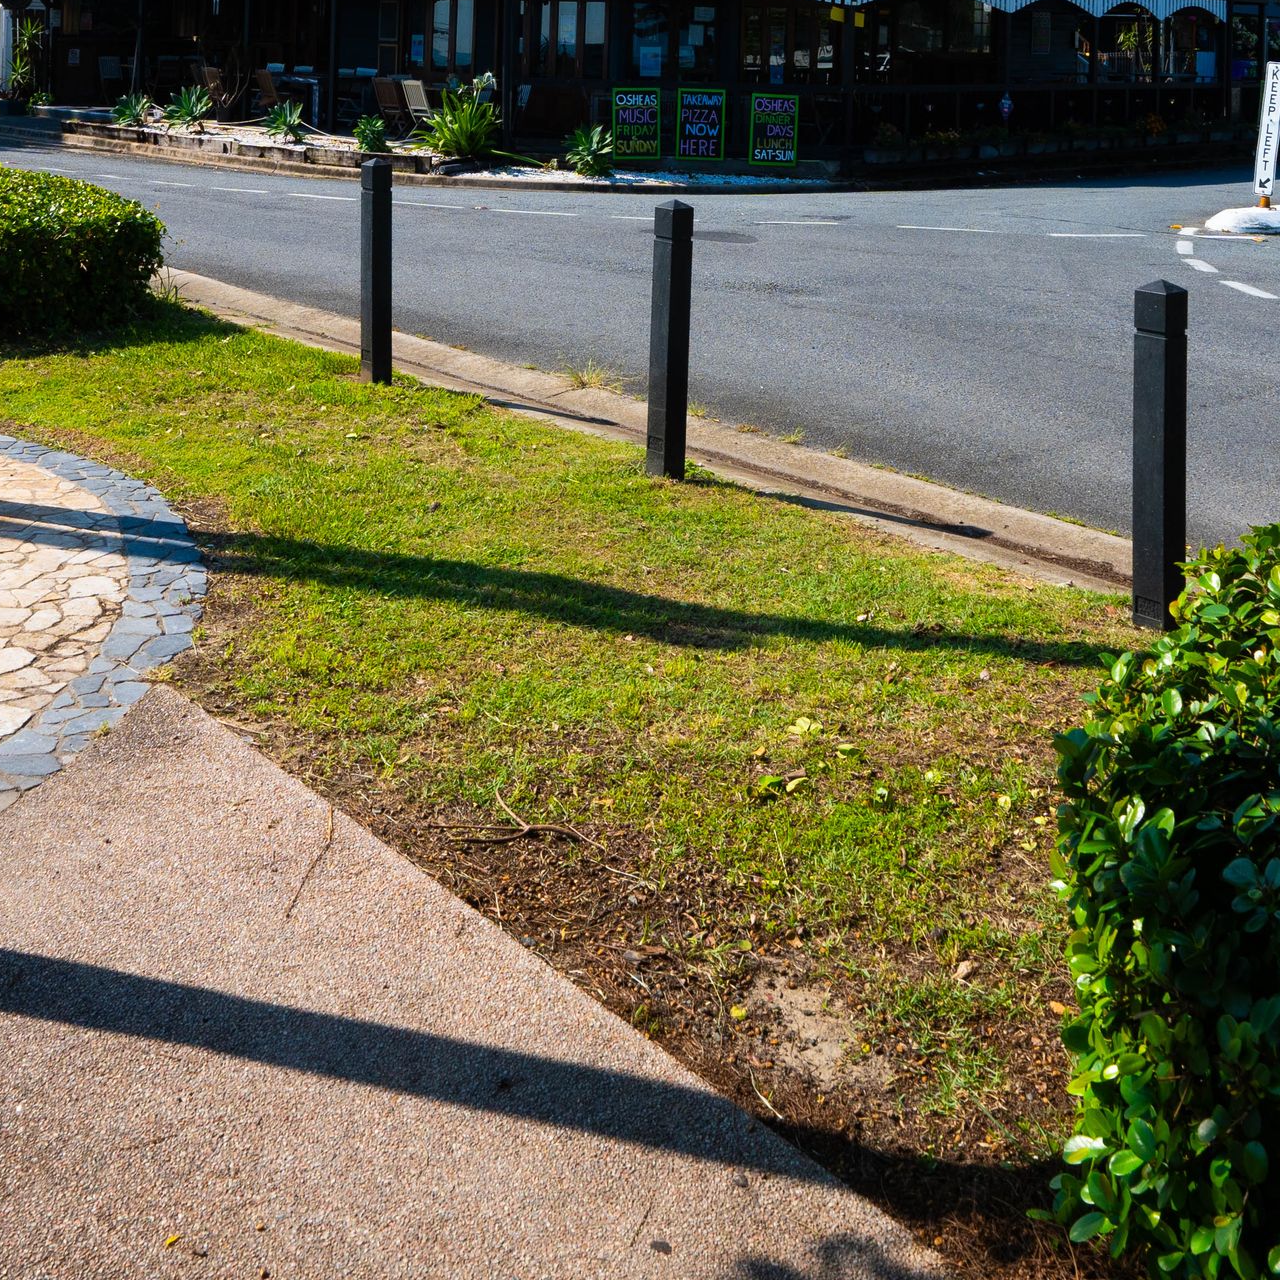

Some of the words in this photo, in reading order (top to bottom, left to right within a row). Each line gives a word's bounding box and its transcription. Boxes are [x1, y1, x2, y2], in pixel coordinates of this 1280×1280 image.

[1268, 68, 1280, 117] KEEP
[682, 94, 724, 106] TAKEAWAY
[619, 108, 657, 123] MUSIC
[681, 108, 719, 123] PIZZA
[755, 113, 791, 125] DINNER
[616, 124, 656, 136] FRIDAY
[685, 123, 720, 137] NOW
[767, 124, 794, 137] DAYS
[616, 140, 658, 154] SUNDAY
[680, 139, 718, 156] HERE
[756, 136, 793, 149] LUNCH
[1262, 123, 1273, 171] LEFT
[754, 148, 795, 161] SAT-SUN
